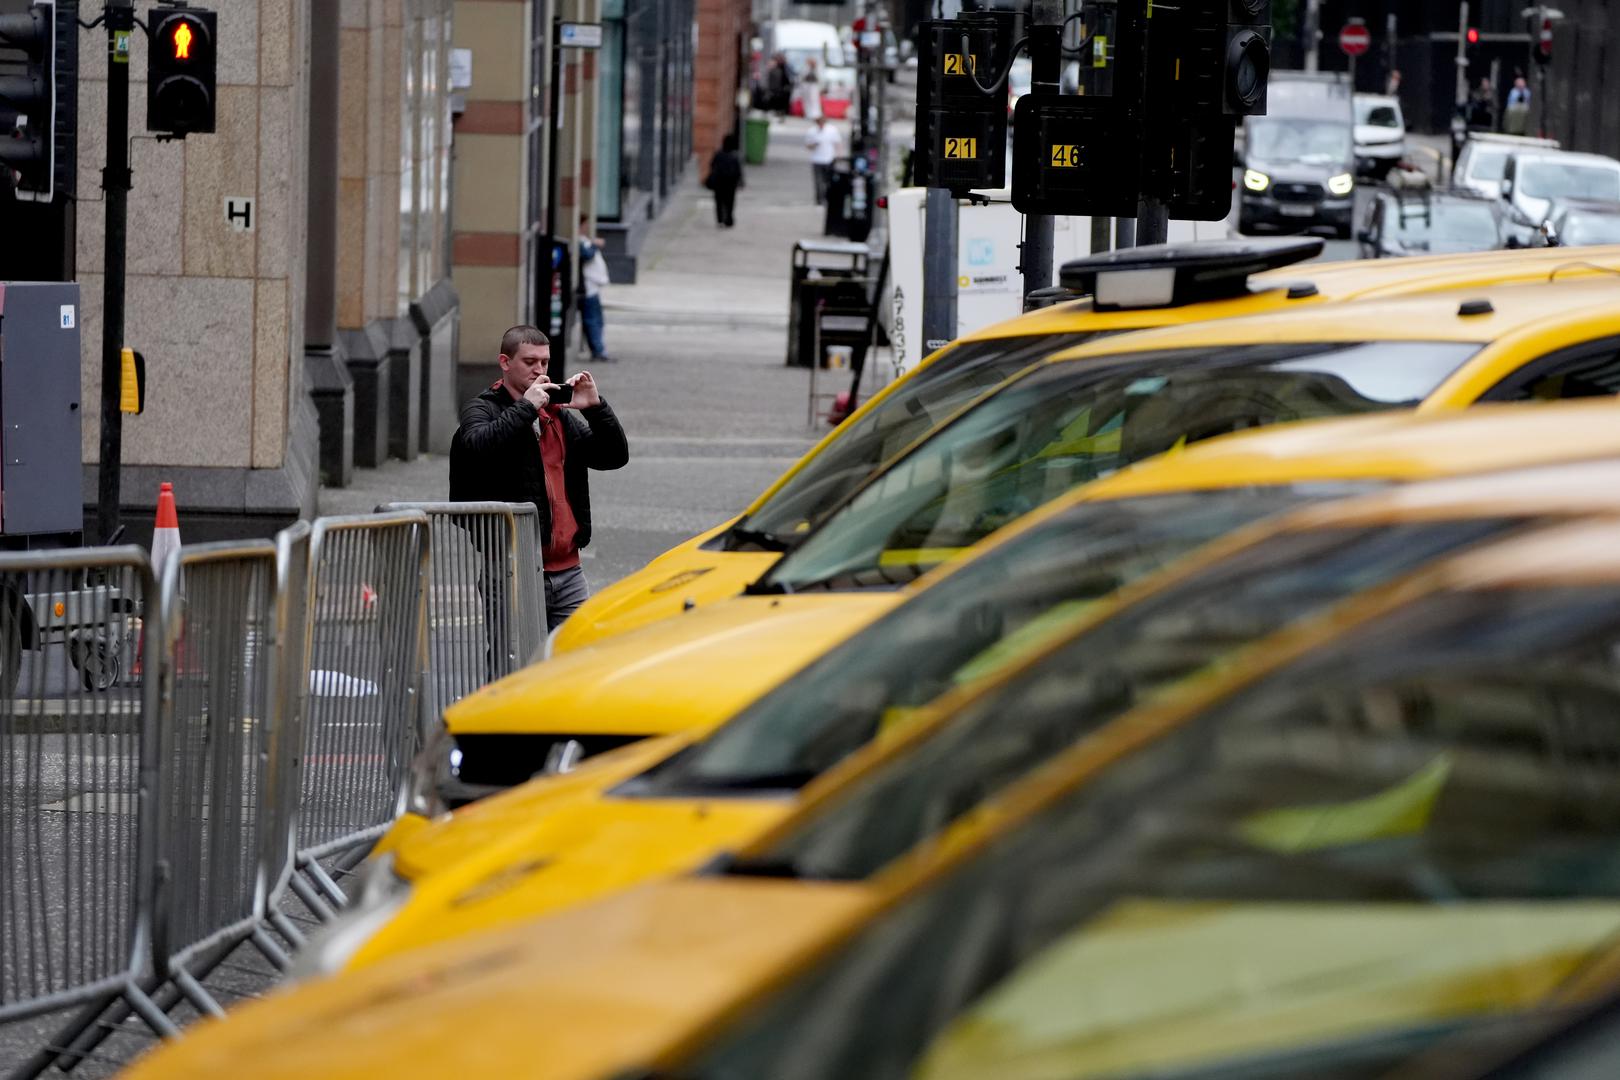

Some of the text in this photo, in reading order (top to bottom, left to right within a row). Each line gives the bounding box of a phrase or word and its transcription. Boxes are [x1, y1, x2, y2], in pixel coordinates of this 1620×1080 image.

[948, 138, 972, 158] 21
[1052, 145, 1079, 166] 46
[228, 201, 250, 228] H
